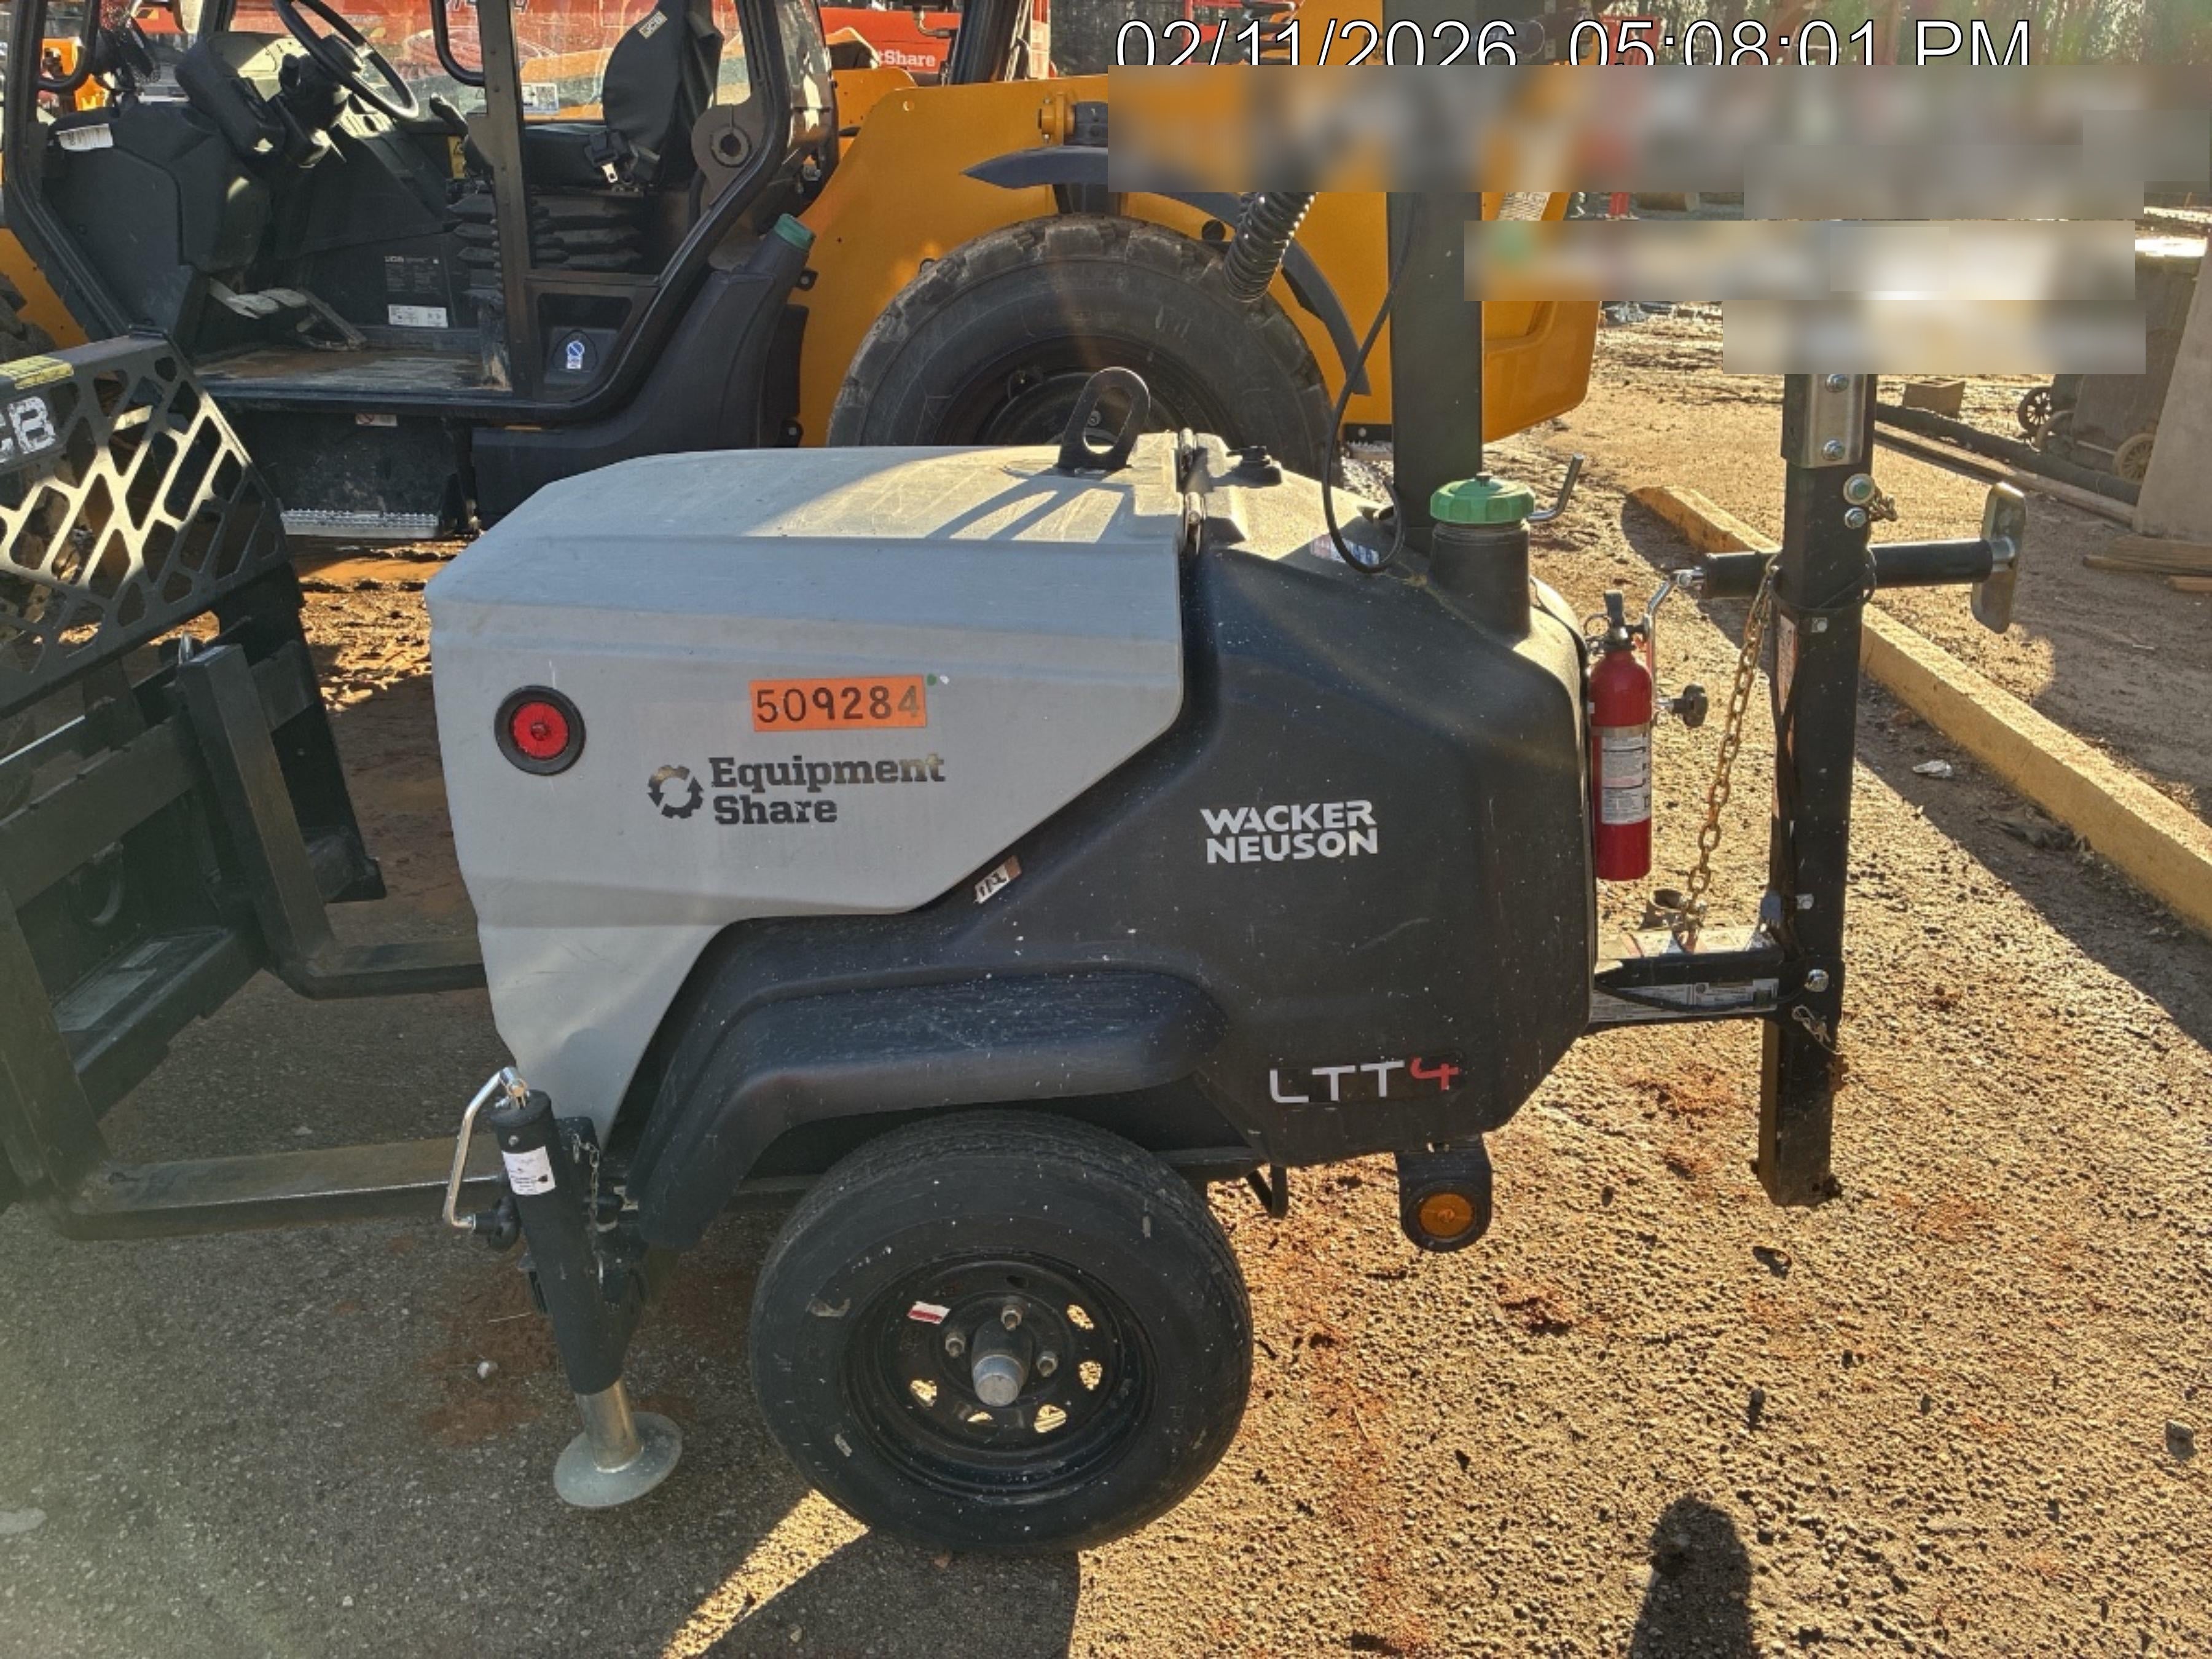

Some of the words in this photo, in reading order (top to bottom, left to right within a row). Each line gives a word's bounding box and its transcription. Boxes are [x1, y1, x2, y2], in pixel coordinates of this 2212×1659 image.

[756, 684, 920, 723] 509284
[708, 752, 946, 793] Equipment
[712, 794, 837, 825] Share
[1199, 799, 1377, 834] WACKER
[1206, 828, 1378, 863] NEUSON
[1269, 1057, 1459, 1104] LTT4
